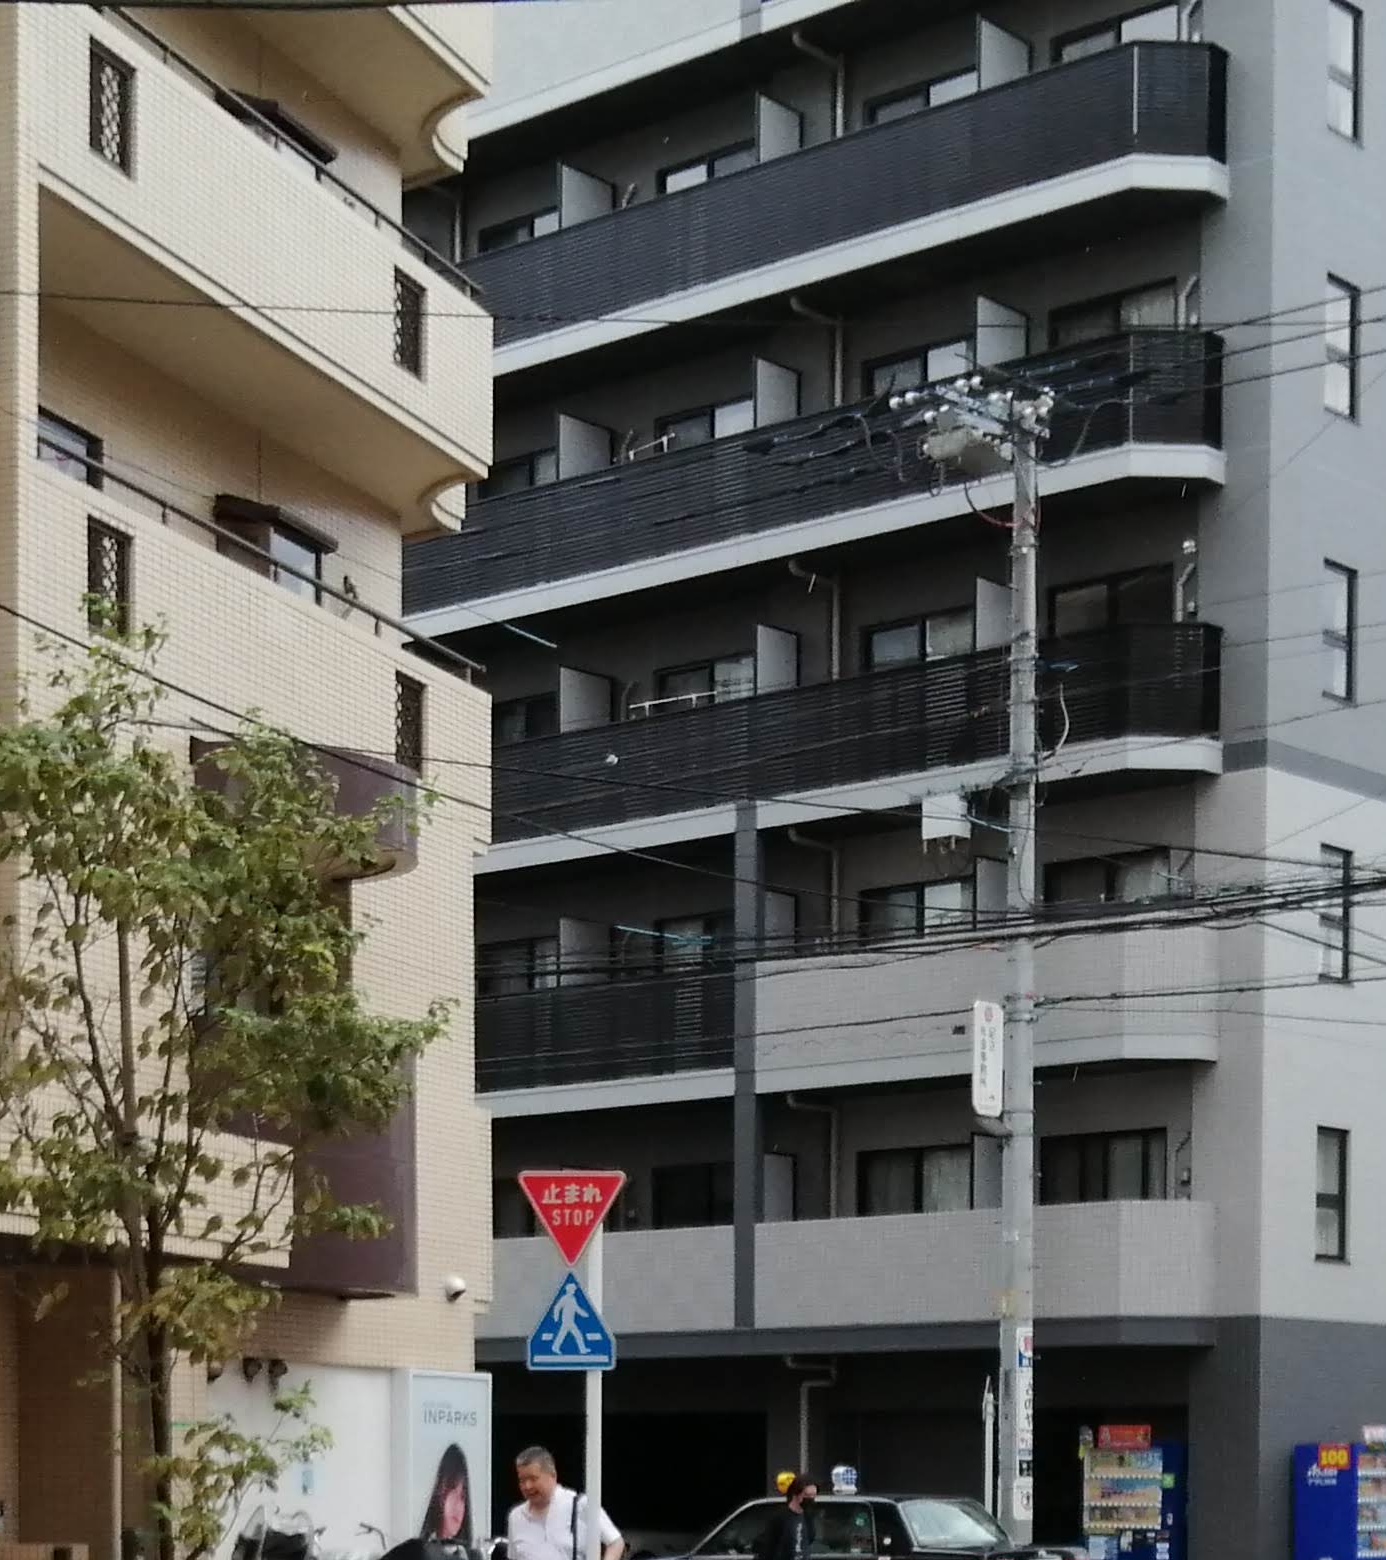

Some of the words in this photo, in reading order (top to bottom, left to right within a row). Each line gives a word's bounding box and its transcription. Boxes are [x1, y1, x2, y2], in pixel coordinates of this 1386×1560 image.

[541, 1183, 603, 1205] 止まれ
[551, 1209, 595, 1226] STOP
[423, 1409, 477, 1426] INPARKS
[1320, 1448, 1349, 1467] 100
